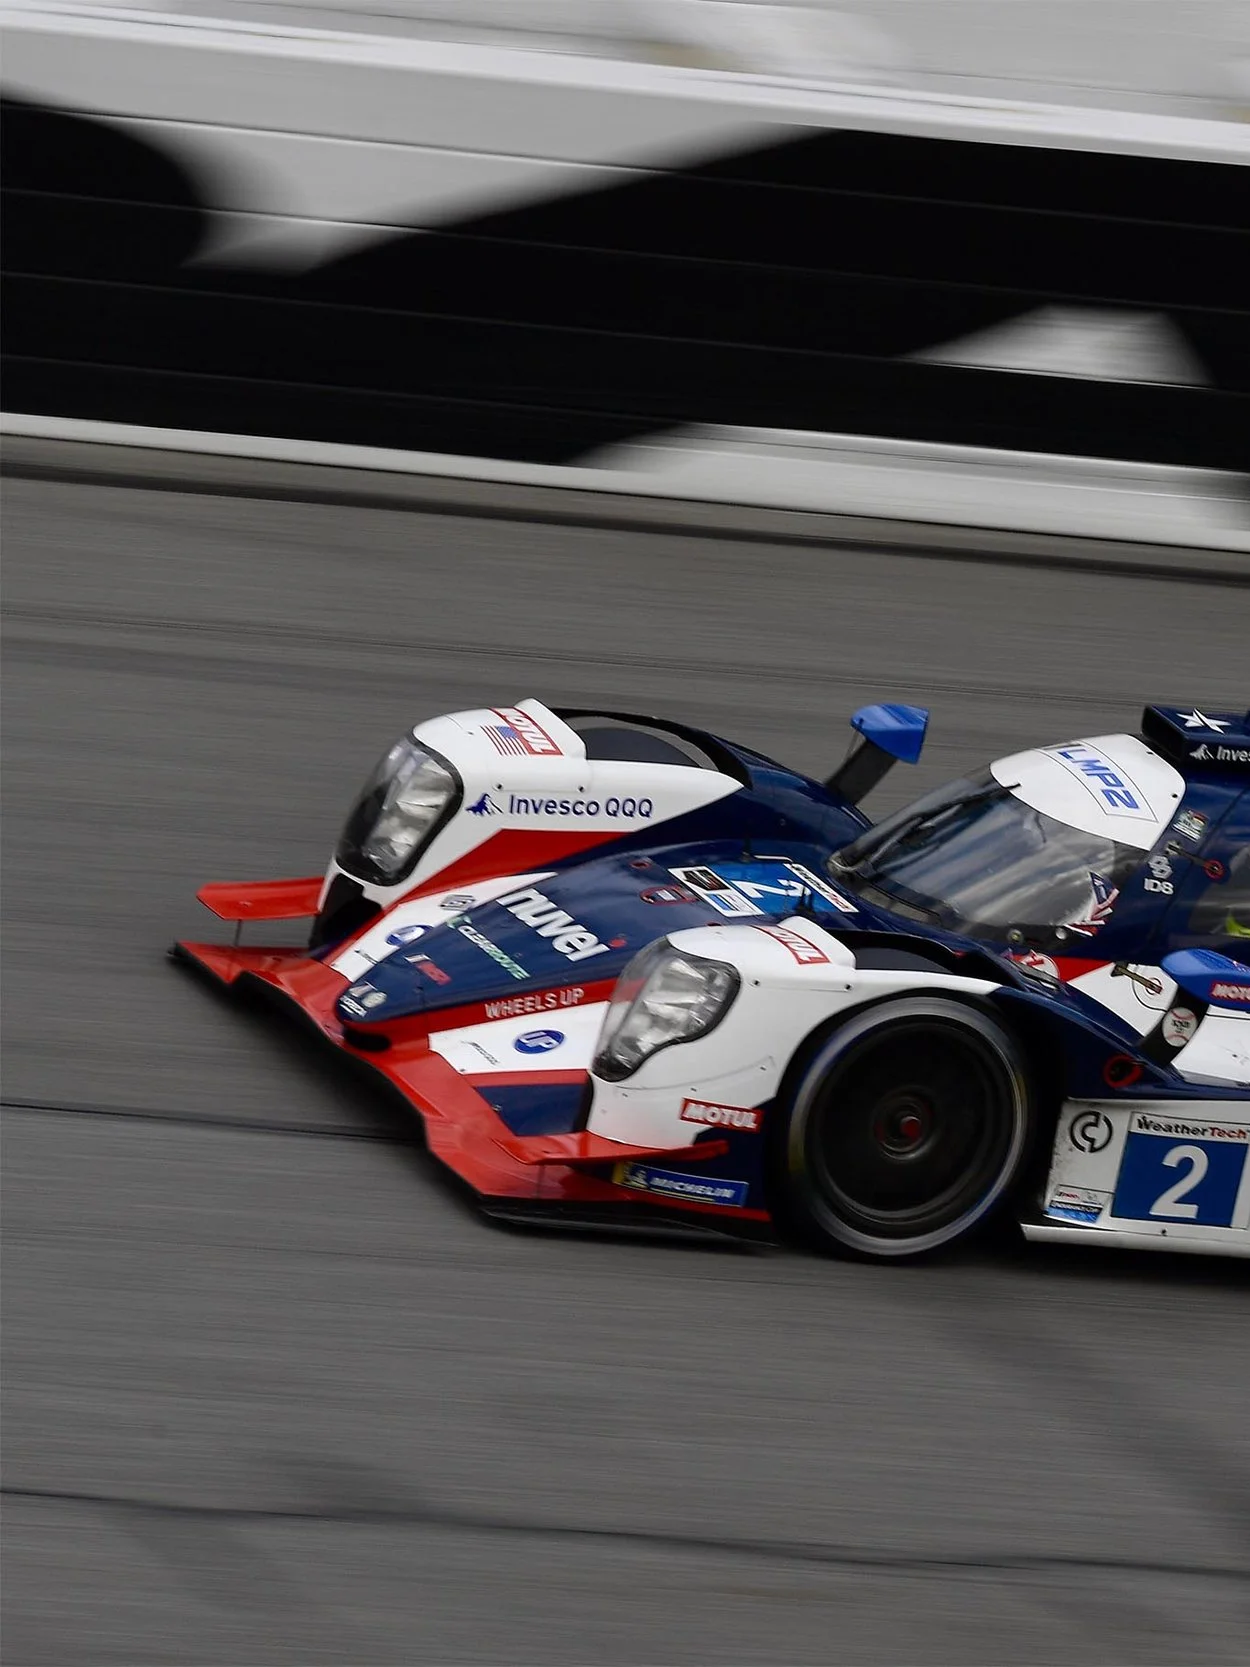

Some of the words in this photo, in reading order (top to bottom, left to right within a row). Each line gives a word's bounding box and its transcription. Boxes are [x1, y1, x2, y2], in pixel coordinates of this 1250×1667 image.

[1056, 748, 1140, 810] LMP2
[509, 795, 600, 816] Invesco
[605, 797, 654, 818] QQQ
[496, 888, 627, 962] nuvei
[485, 993, 557, 1018] WHEELS
[560, 988, 585, 1006] UP
[683, 1102, 757, 1129] MOTUL
[1137, 1115, 1248, 1139] WeatherTech
[650, 1177, 736, 1198] MICHELIN
[1149, 1145, 1209, 1219] 2
